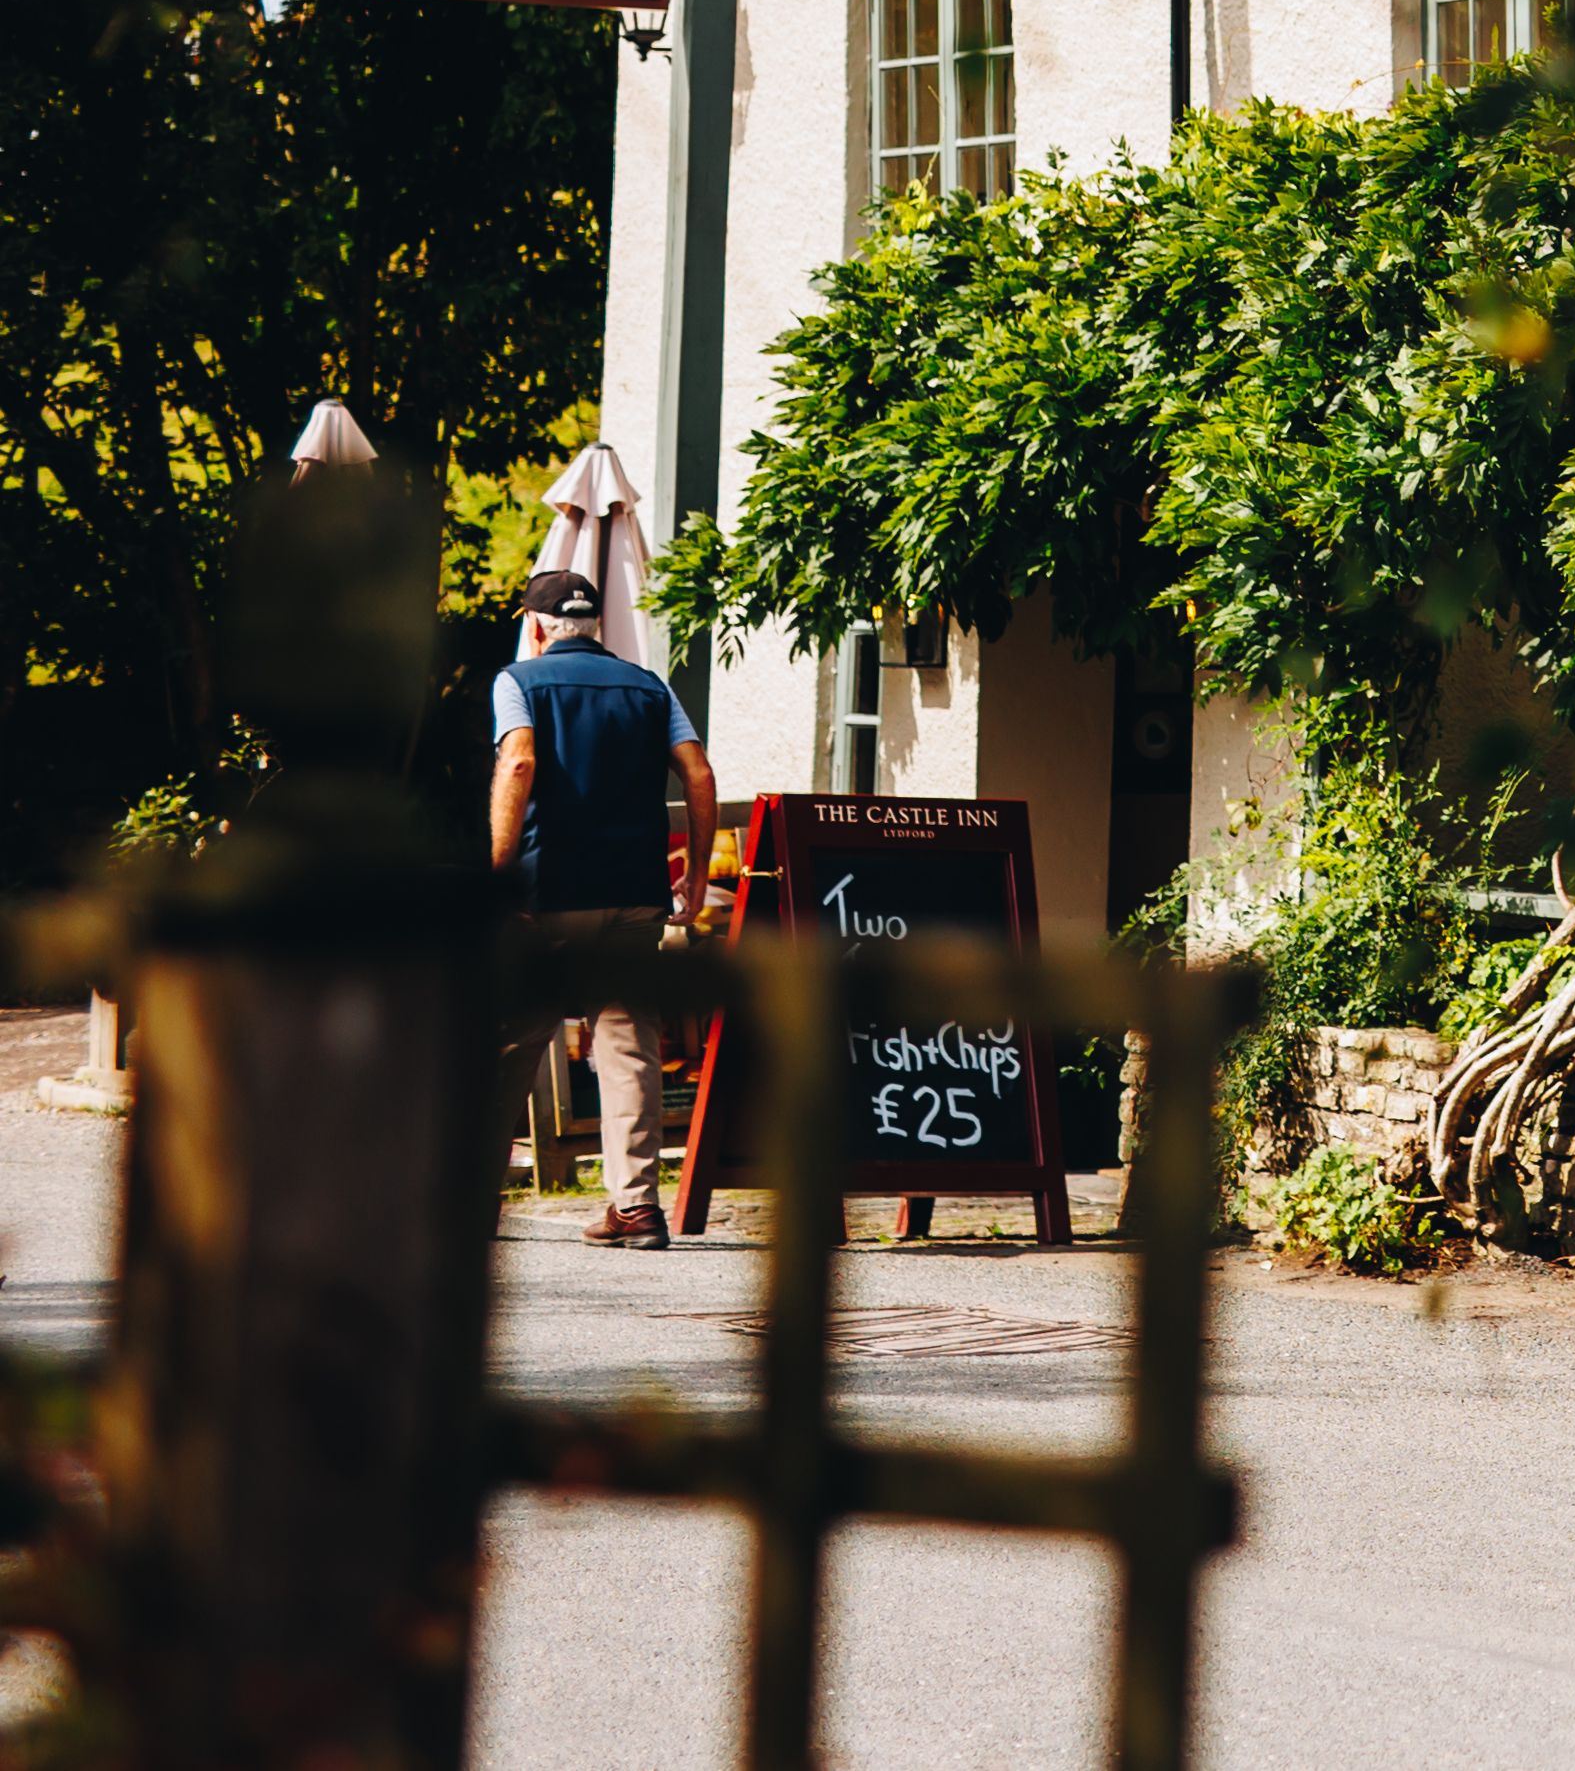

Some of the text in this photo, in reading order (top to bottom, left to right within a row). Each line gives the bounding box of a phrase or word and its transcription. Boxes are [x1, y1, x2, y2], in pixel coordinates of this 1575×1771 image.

[814, 803, 1001, 828] THE CASTLE INN
[883, 828, 936, 840] LYDFORD
[822, 872, 908, 941] Two
[871, 1082, 983, 1149] £25
